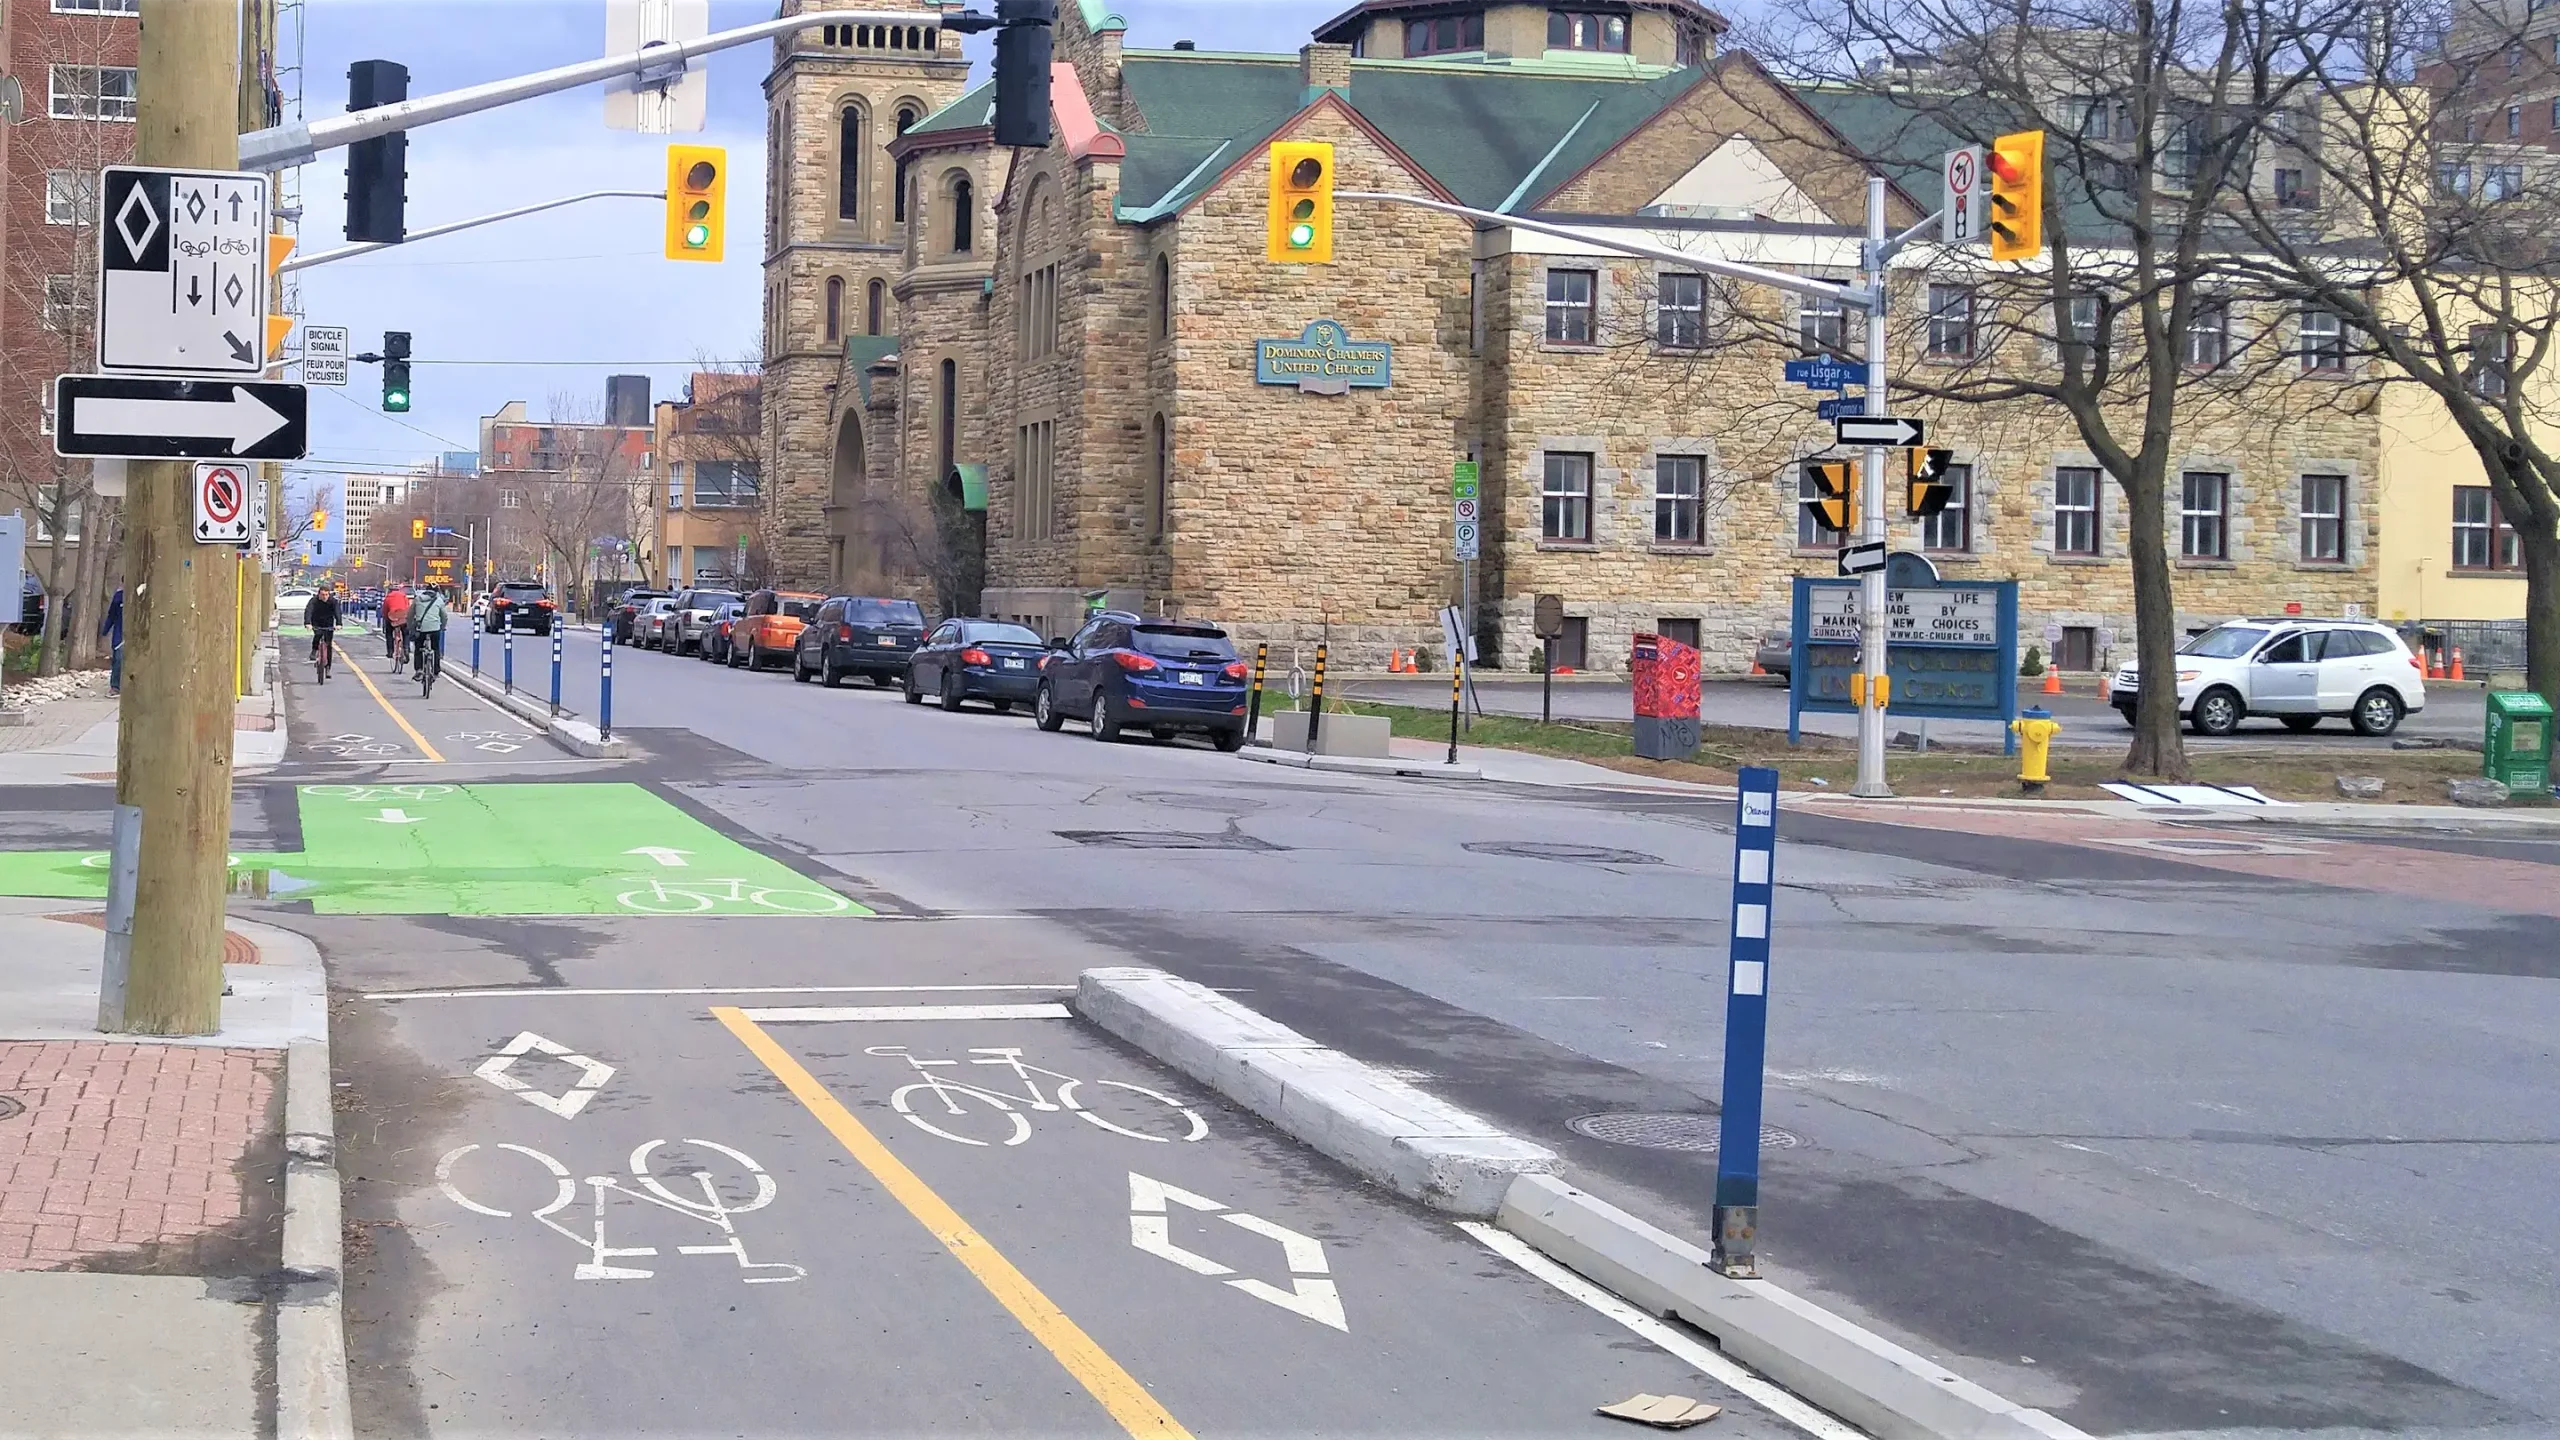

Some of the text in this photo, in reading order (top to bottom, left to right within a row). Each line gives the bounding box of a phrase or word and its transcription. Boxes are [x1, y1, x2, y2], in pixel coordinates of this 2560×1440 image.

[309, 330, 342, 340] BICYCLE
[311, 342, 340, 351] SIGNAL
[1265, 345, 1385, 361] DOMINION-CHALMERS
[306, 360, 344, 369] FEUX POUR
[1271, 360, 1376, 375] UNITED CHURCH
[306, 371, 344, 381] CYCLISTES
[1797, 369, 1808, 377] rue
[1811, 364, 1841, 381] Lisgar
[1847, 591, 1853, 600] A
[1954, 594, 1979, 604] LIFE
[1844, 604, 1854, 614] IS
[1942, 606, 1957, 616] BY
[1822, 616, 1979, 630] MAKIN NEW CHOICES
[1814, 629, 1851, 637] SUNDAYS
